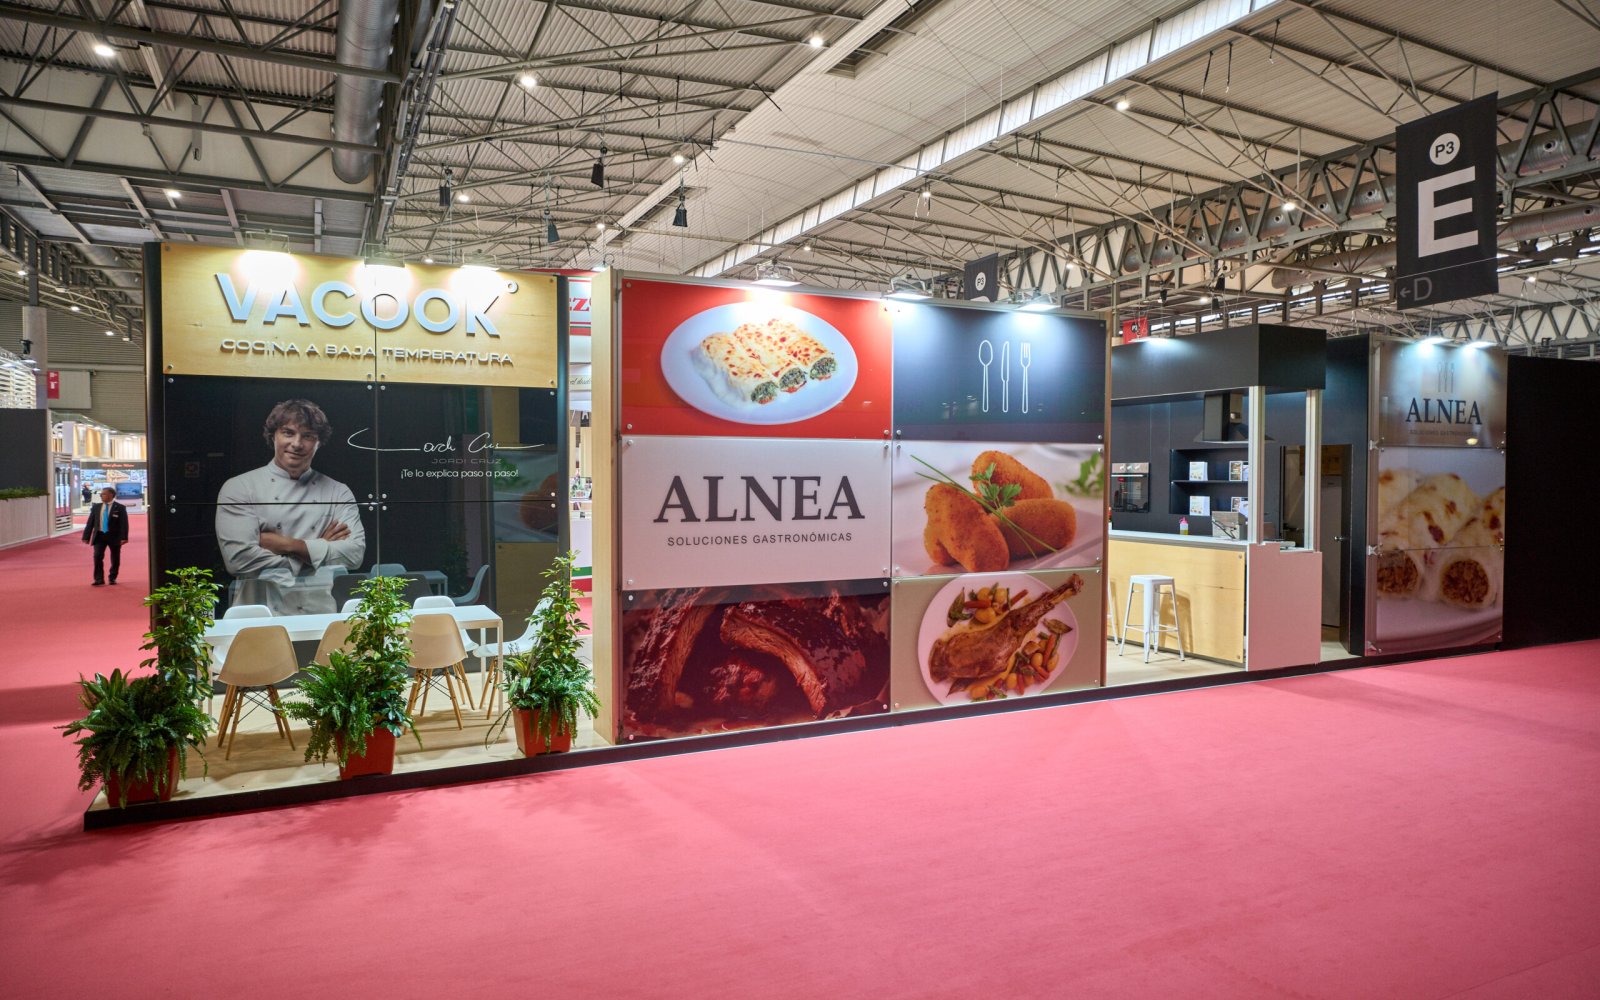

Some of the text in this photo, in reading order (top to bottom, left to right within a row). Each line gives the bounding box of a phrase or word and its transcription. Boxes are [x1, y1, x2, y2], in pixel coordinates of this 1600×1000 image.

[1435, 141, 1455, 159] P3
[1417, 165, 1479, 258] E
[977, 277, 985, 287] P3
[1414, 276, 1433, 301] D
[220, 338, 514, 365] COCINA A BAJA TEMPERATURA
[1405, 396, 1483, 425] ALNEA
[400, 468, 519, 479] ¡Te lo explica paso a paso!
[653, 475, 866, 523] ALNEA
[667, 532, 853, 547] SOLUCIONES GASTRONÓMICAS
